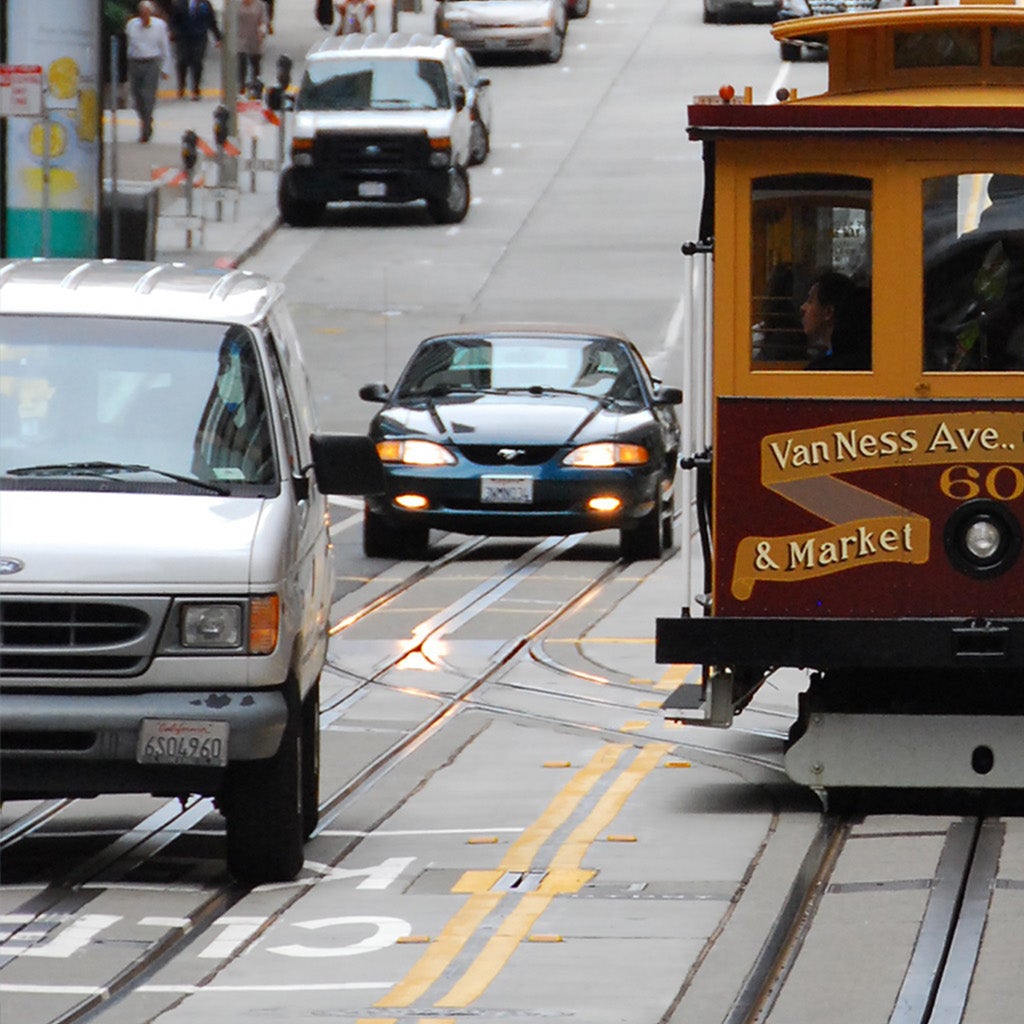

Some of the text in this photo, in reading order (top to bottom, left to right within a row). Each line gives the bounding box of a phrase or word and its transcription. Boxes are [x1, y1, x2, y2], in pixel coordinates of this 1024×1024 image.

[771, 438, 830, 470] Van
[834, 429, 919, 462] Ness
[754, 522, 914, 571] & Market
[145, 736, 222, 759] 6S04960
